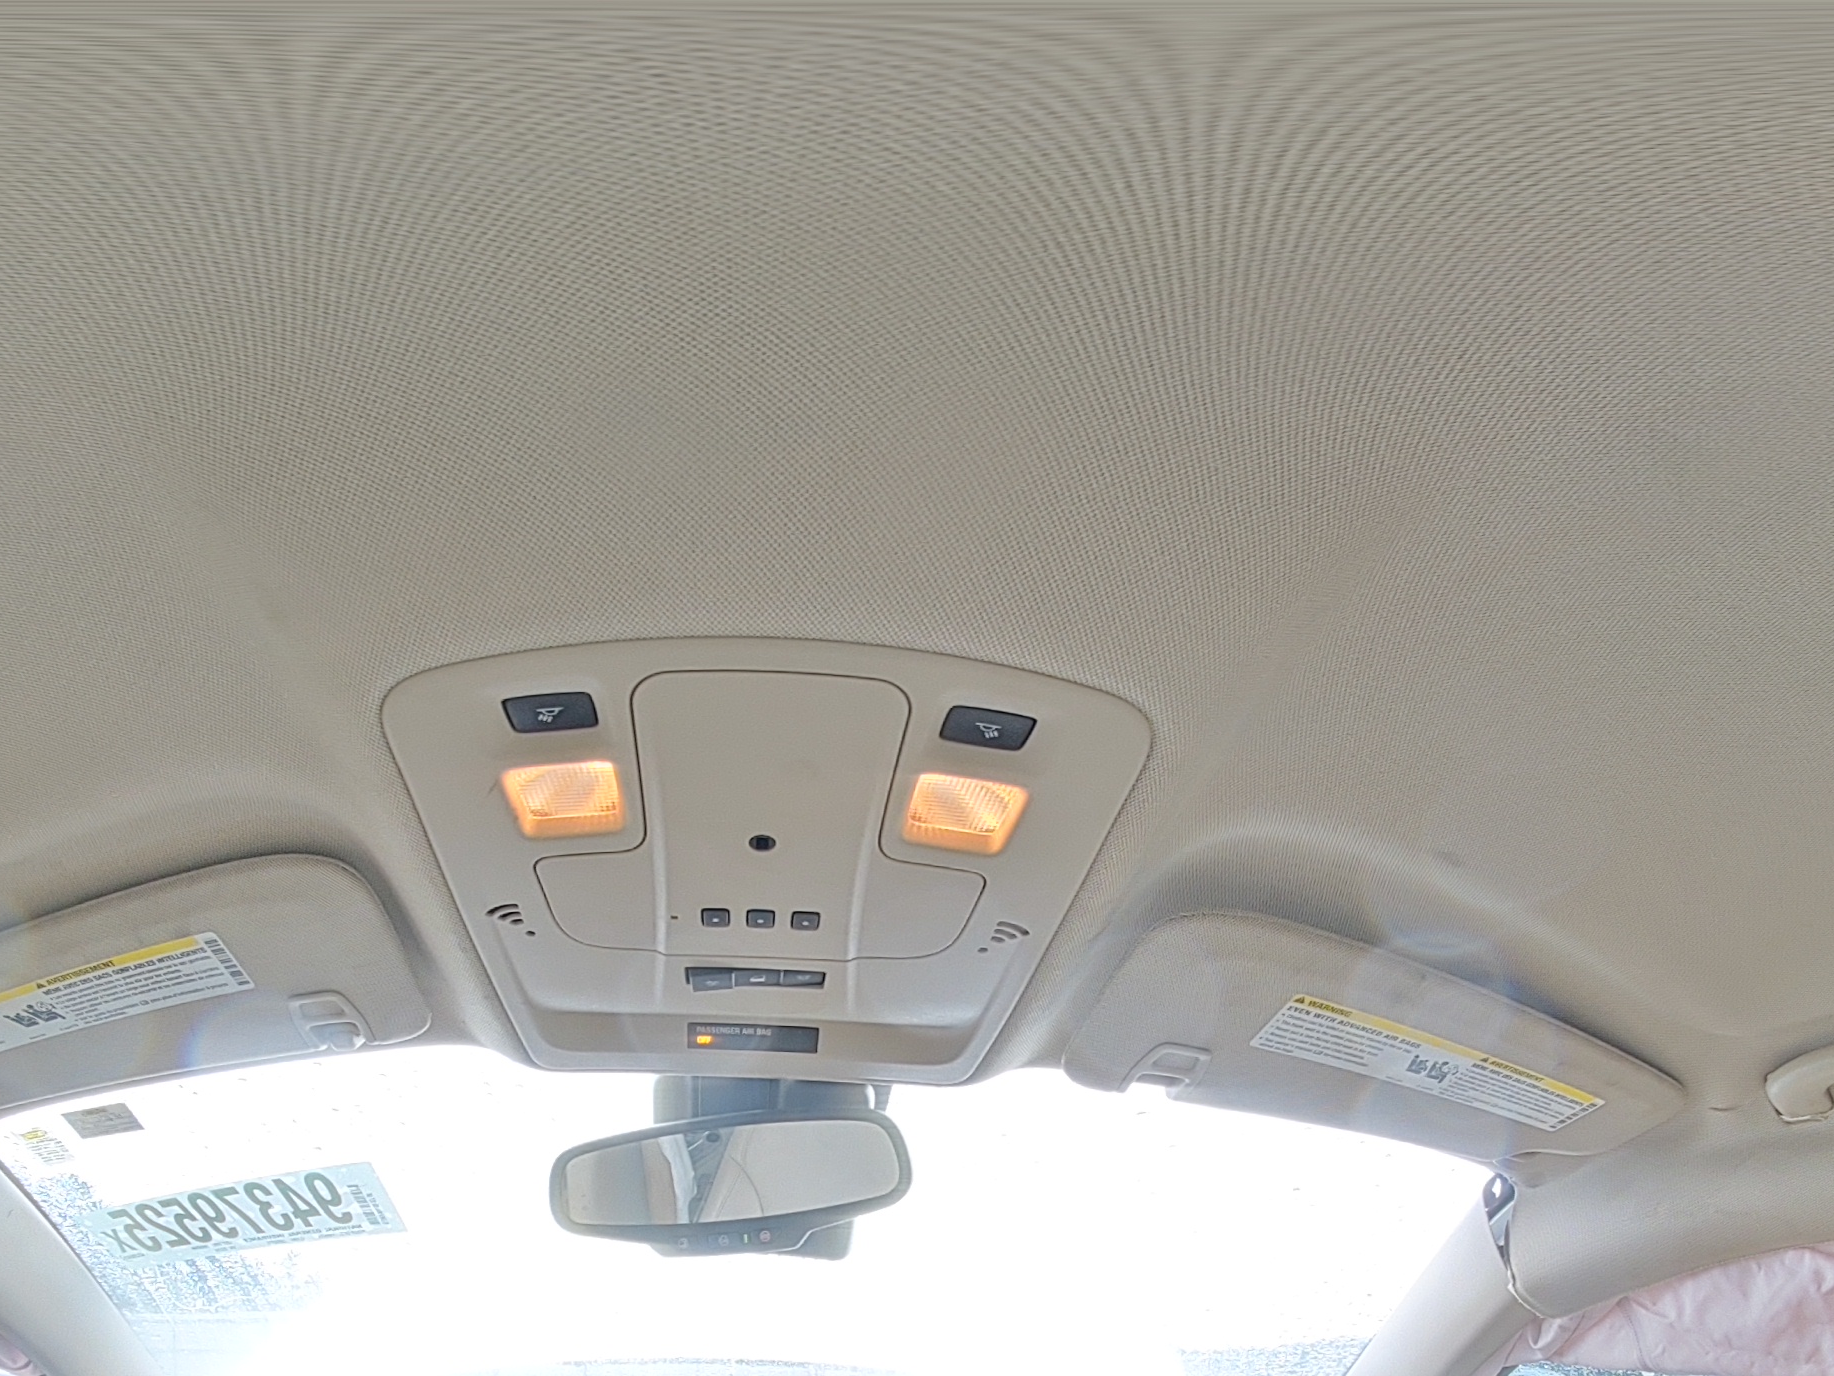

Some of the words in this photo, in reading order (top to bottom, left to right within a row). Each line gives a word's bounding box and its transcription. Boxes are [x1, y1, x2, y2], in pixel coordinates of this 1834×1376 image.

[1286, 1005, 1312, 1017] EVEN
[1312, 1012, 1337, 1024] WITH
[1308, 1000, 1353, 1018] WARNING
